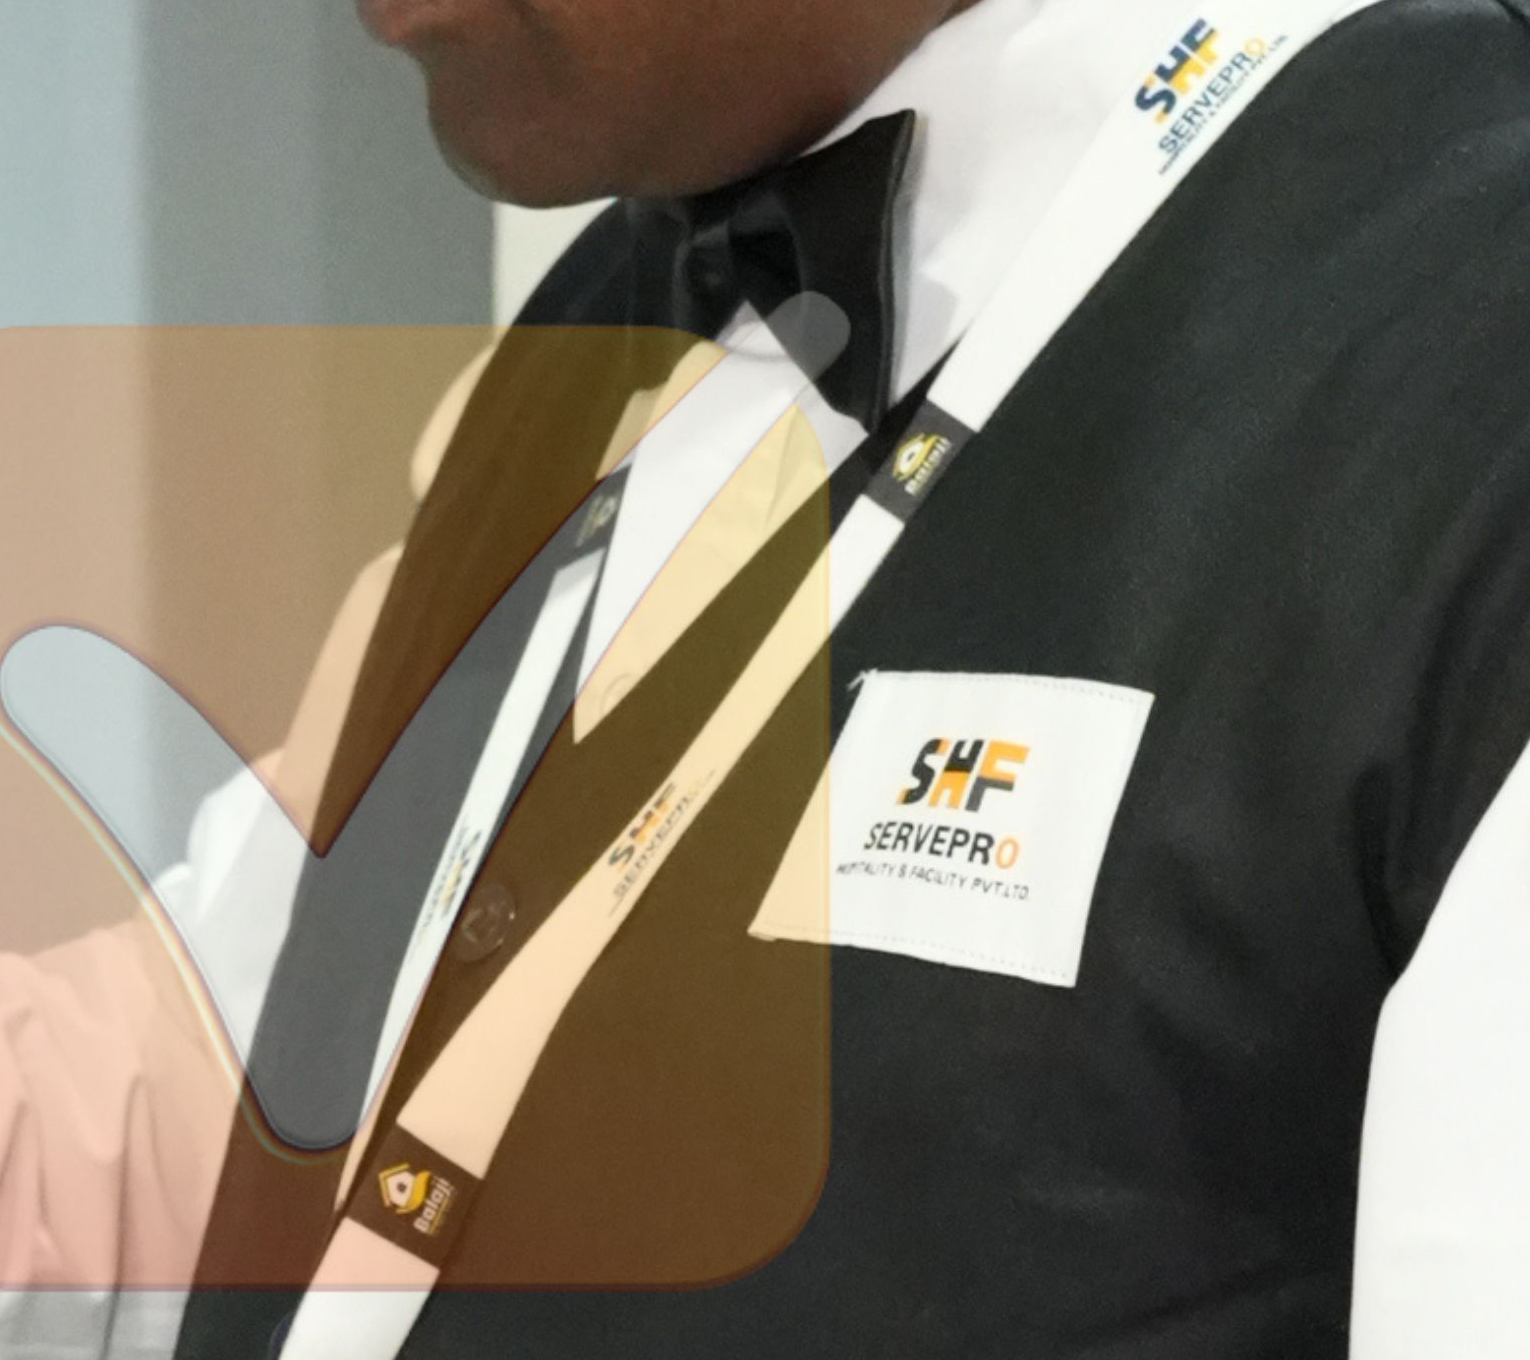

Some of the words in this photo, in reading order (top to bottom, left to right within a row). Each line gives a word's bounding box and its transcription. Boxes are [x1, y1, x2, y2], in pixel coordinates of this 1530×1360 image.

[1158, 36, 1265, 154] SERVEPRO
[895, 737, 1031, 813] SHF
[863, 821, 1020, 870] SERVEPRO
